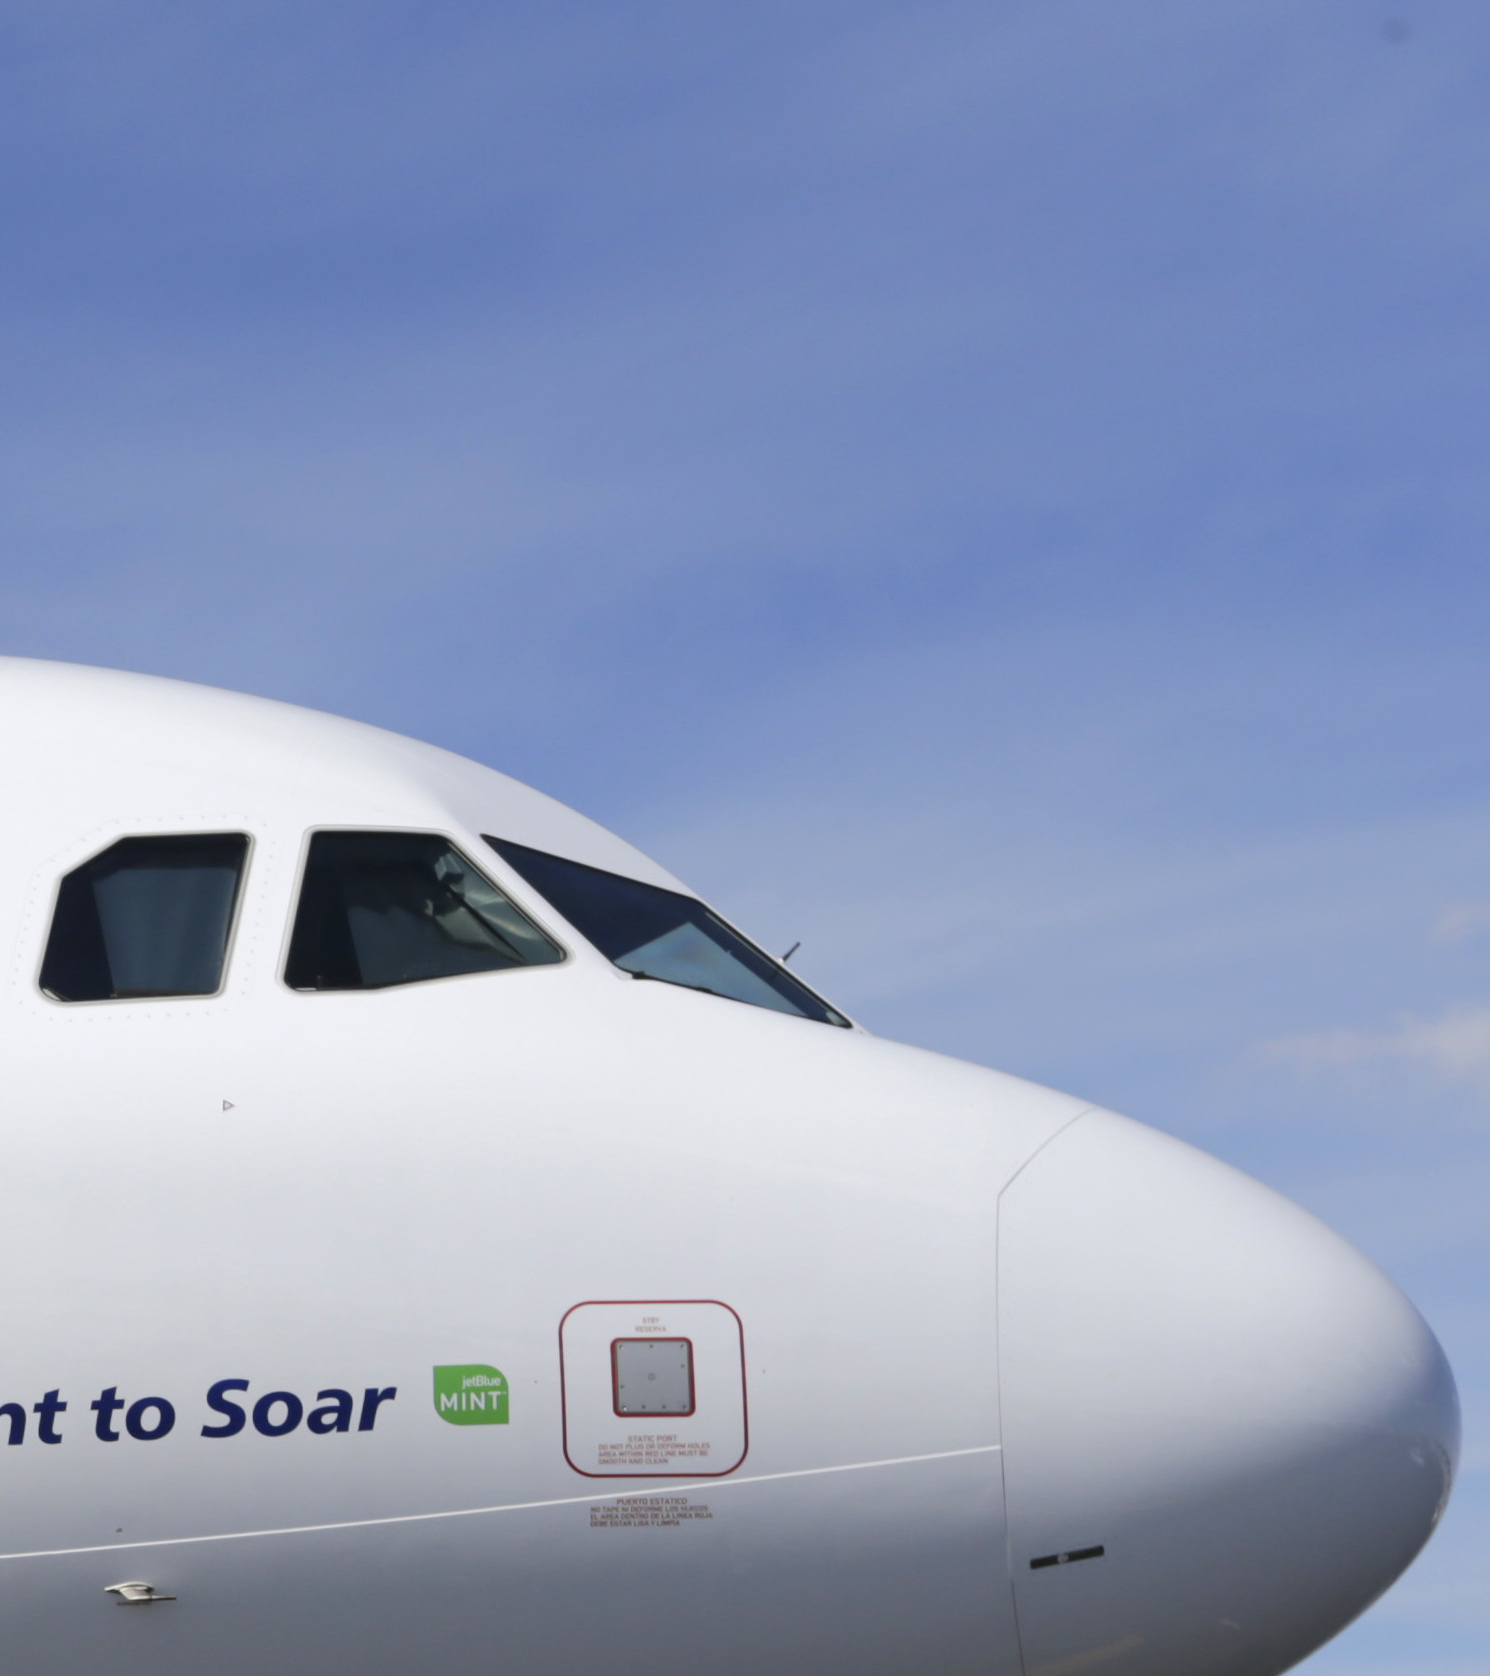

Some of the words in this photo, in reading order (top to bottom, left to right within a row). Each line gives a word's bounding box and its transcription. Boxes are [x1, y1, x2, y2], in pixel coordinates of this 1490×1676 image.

[462, 1374, 502, 1390] jetBlue
[91, 1385, 176, 1442] to
[200, 1379, 397, 1439] Soar
[440, 1391, 502, 1412] MINT
